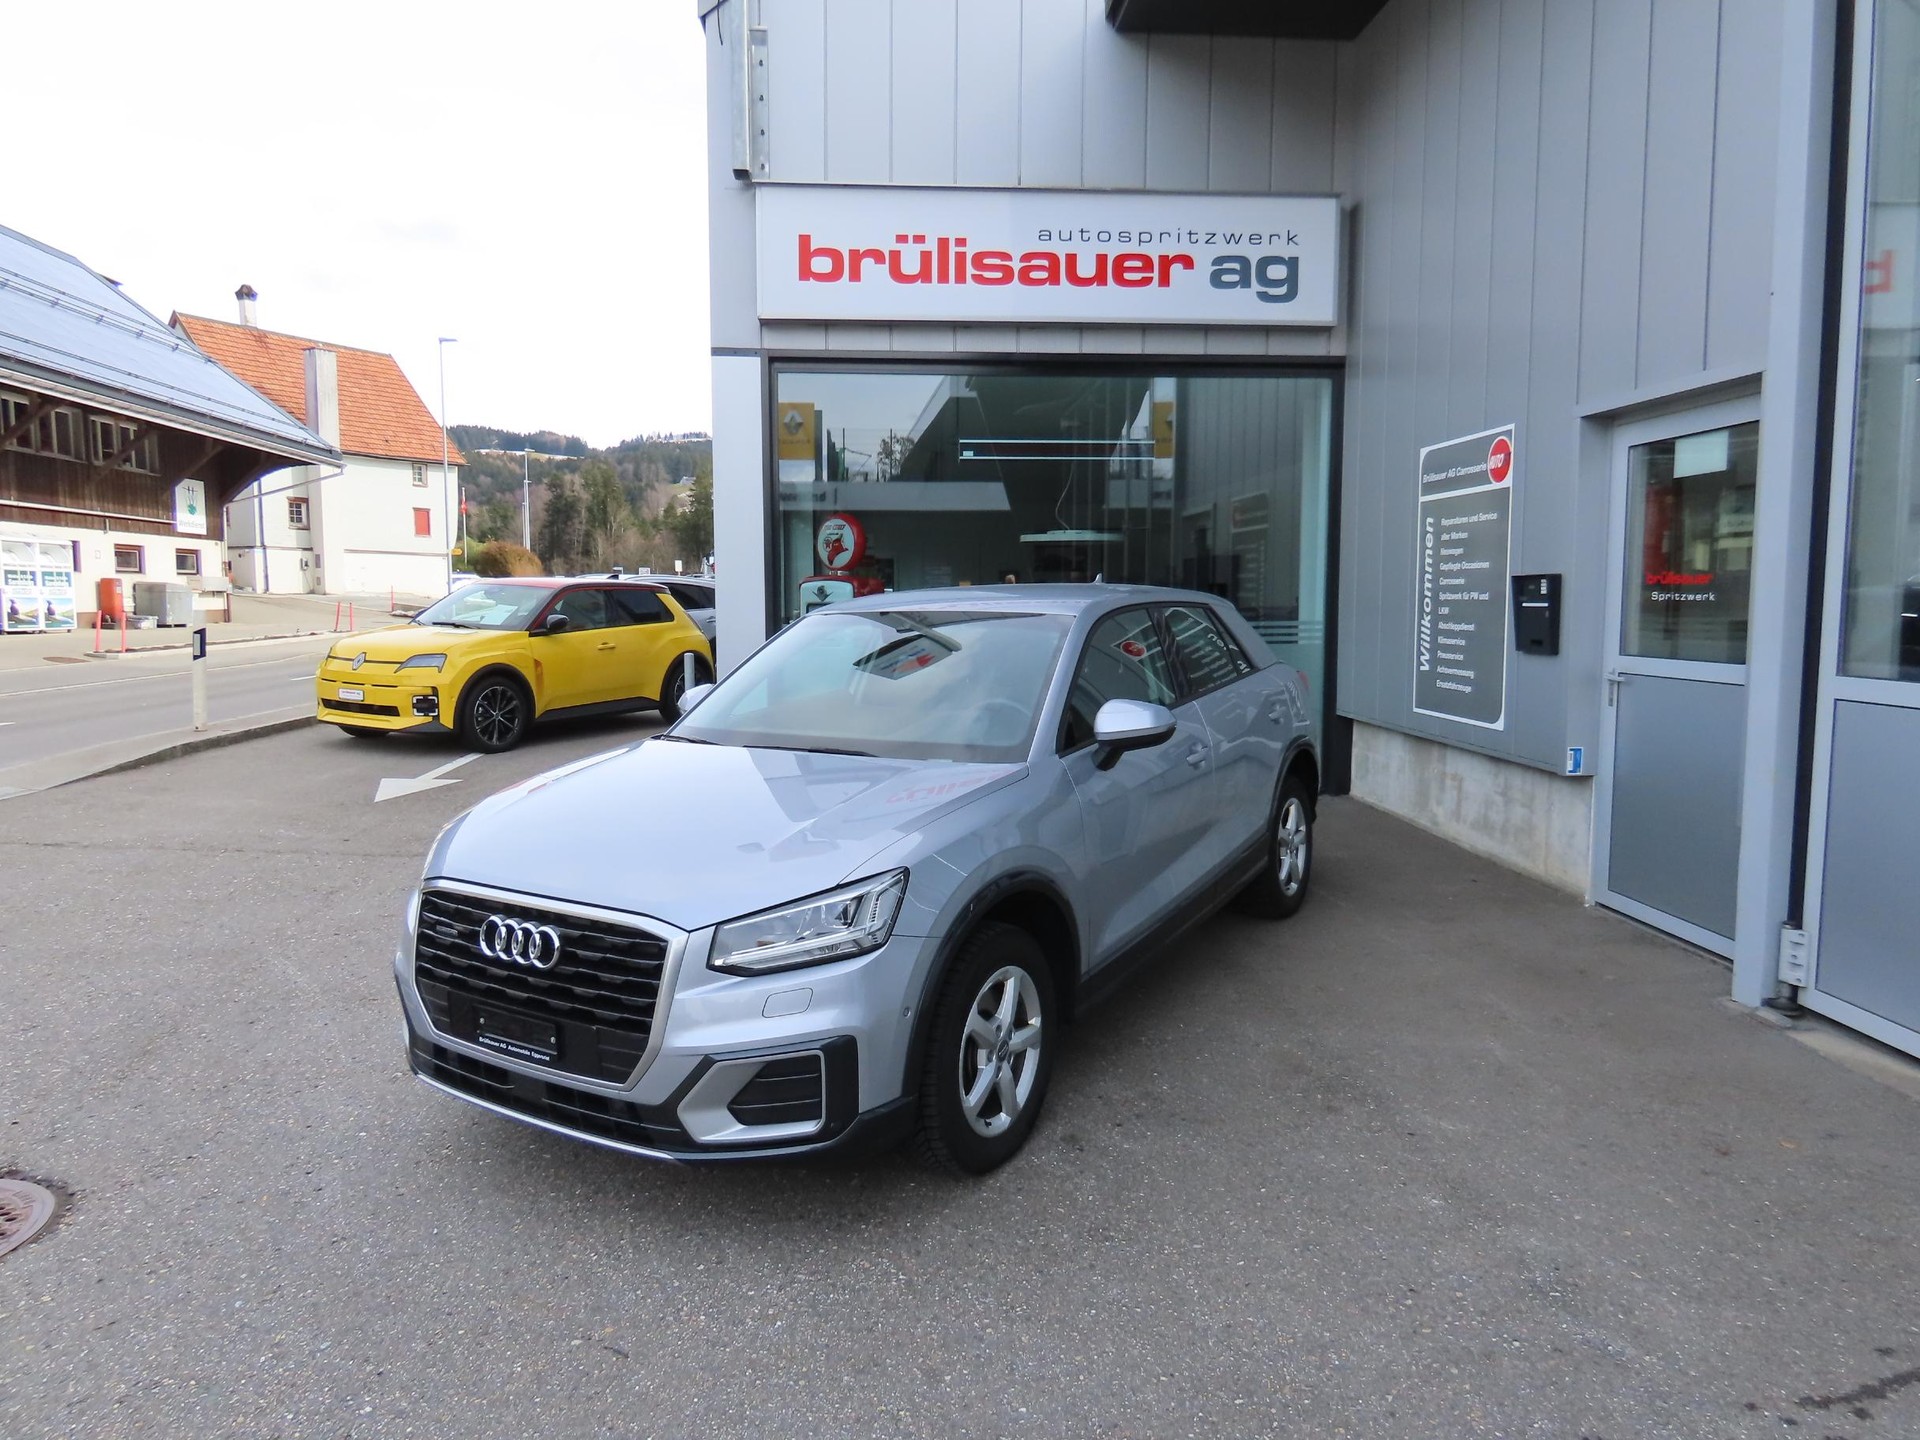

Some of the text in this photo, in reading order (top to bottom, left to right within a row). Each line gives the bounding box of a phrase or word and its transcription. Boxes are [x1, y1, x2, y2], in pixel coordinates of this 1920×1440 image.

[1038, 227, 1299, 247] autospritzwerk
[798, 233, 1300, 304] brülisauer ag
[1422, 461, 1487, 484] Brülisauer AG Carrosserie
[1469, 514, 1478, 522] und
[1479, 512, 1498, 522] Service
[1646, 570, 1713, 585] brülisauer
[1420, 517, 1434, 671] Willkommen
[1470, 592, 1479, 600] PW
[1479, 592, 1489, 601] und
[1651, 591, 1715, 602] Spritzwerk
[1438, 607, 1450, 615] LKW
